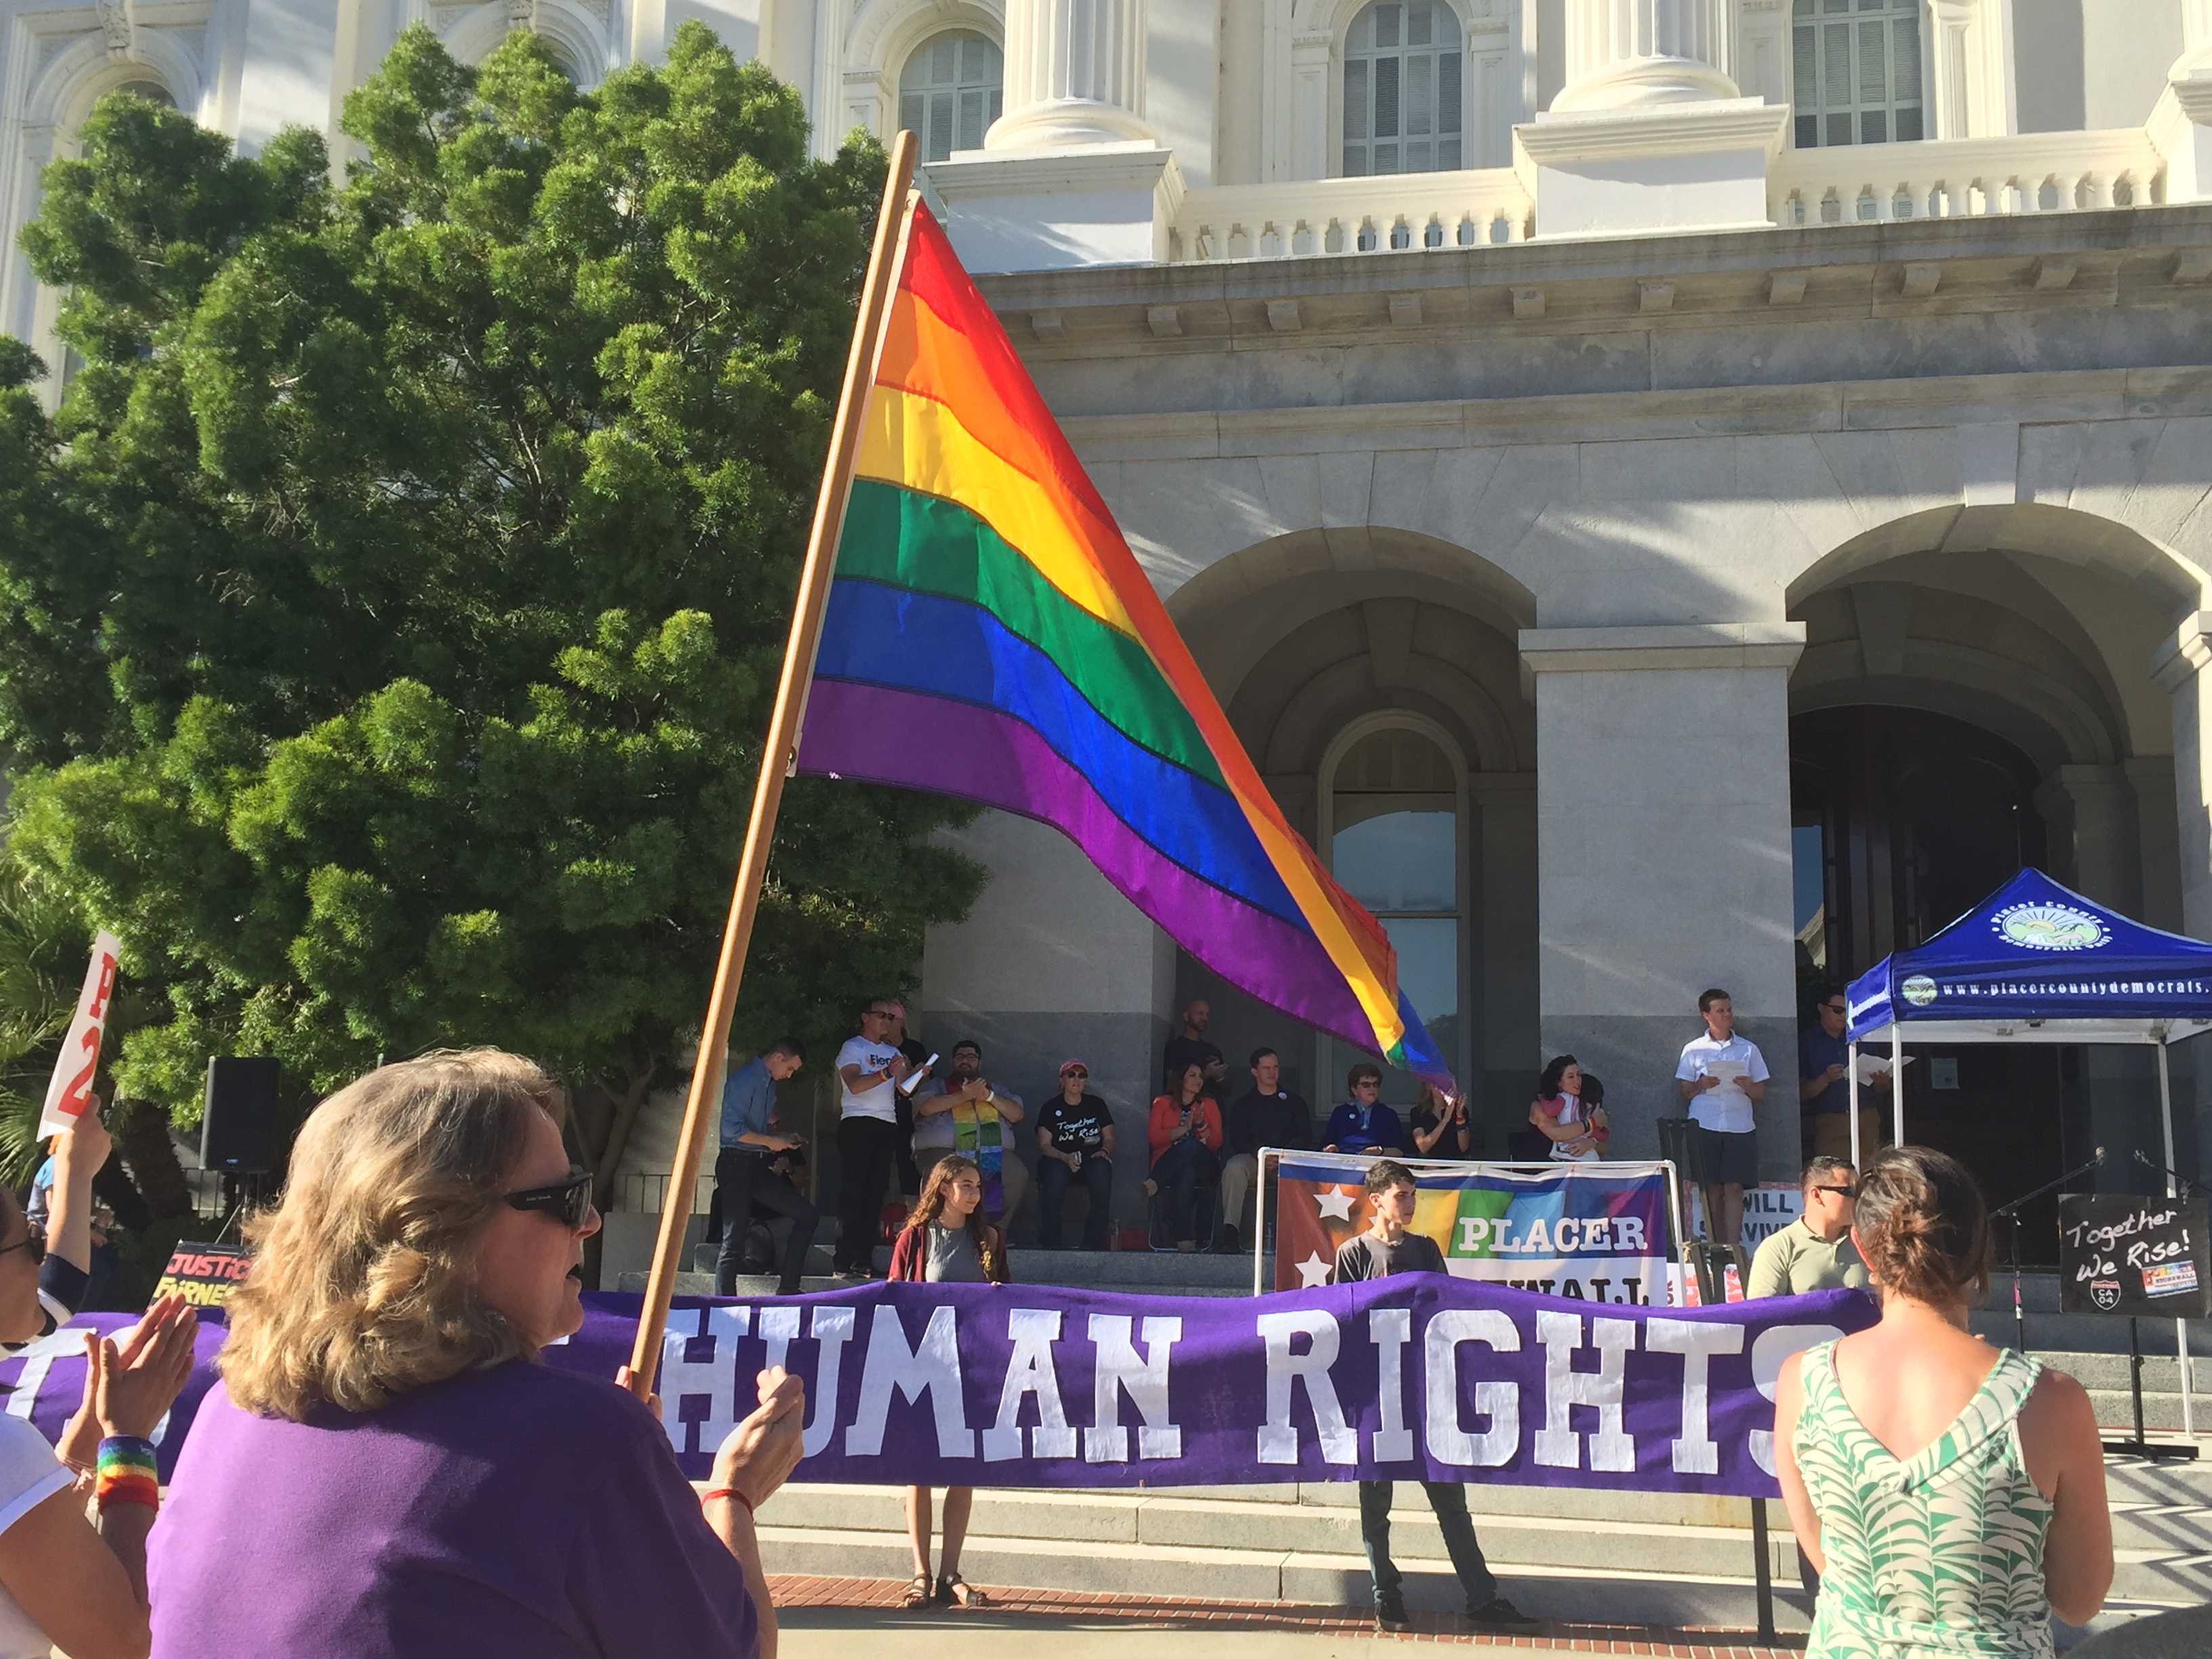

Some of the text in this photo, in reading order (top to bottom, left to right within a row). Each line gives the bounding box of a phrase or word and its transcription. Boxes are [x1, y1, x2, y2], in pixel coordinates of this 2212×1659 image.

[869, 1054, 892, 1065] Elen
[1458, 1216, 1648, 1252] PLACER
[2066, 1210, 2177, 1252] Together
[166, 1253, 253, 1280] JUSTiC
[2076, 1229, 2190, 1282] We Rise!
[2099, 1296, 2114, 1305] 04
[657, 1305, 1182, 1463] HUMAN
